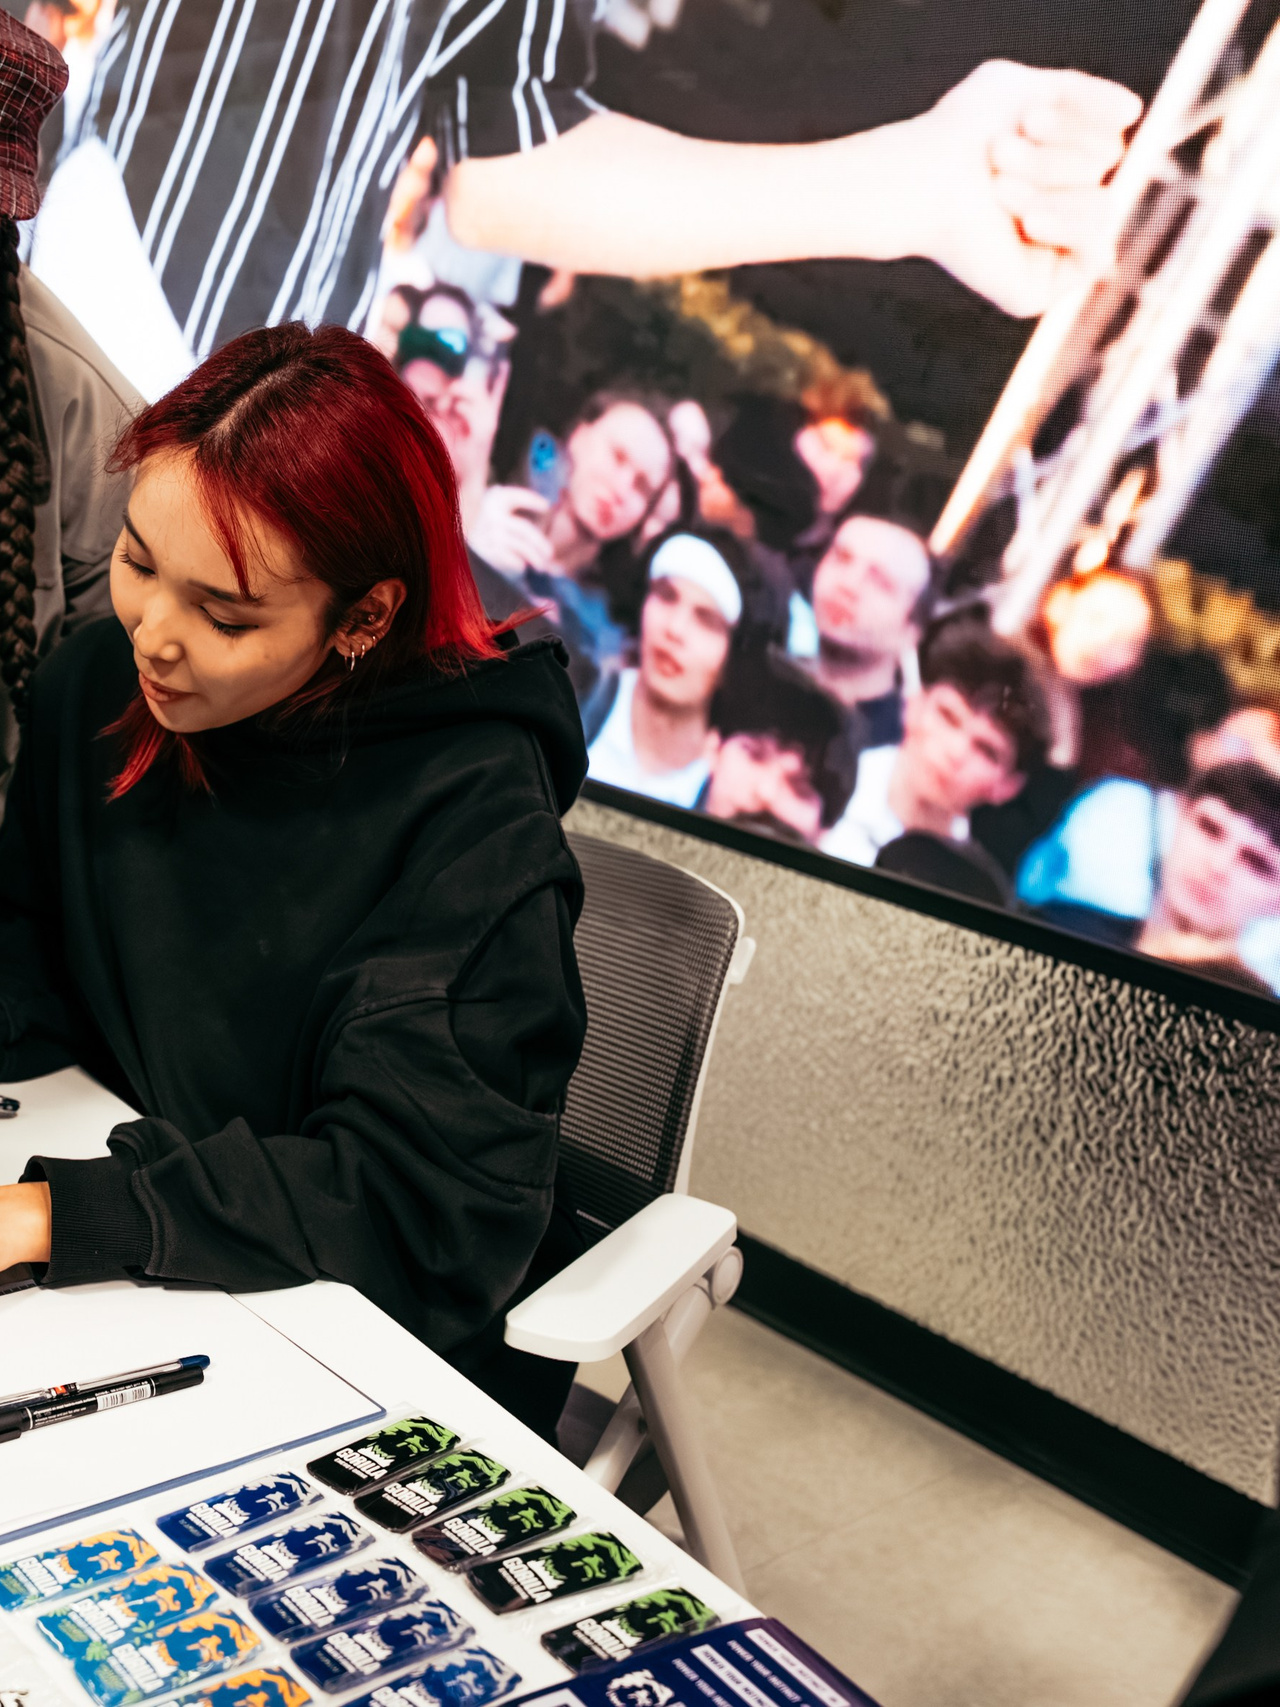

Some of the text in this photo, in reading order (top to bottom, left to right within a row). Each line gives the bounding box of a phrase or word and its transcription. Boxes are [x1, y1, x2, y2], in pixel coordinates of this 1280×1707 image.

[336, 1447, 388, 1480] GORILLA
[384, 1482, 437, 1516] GORILLA
[189, 1502, 239, 1538] GORILLA
[443, 1517, 497, 1556] GORILLA
[237, 1544, 289, 1583] GORILLA
[502, 1556, 553, 1604] GORILLA
[285, 1586, 335, 1628] GORILLA
[327, 1632, 381, 1675] GORILLA
[575, 1617, 633, 1662] GORILLA
